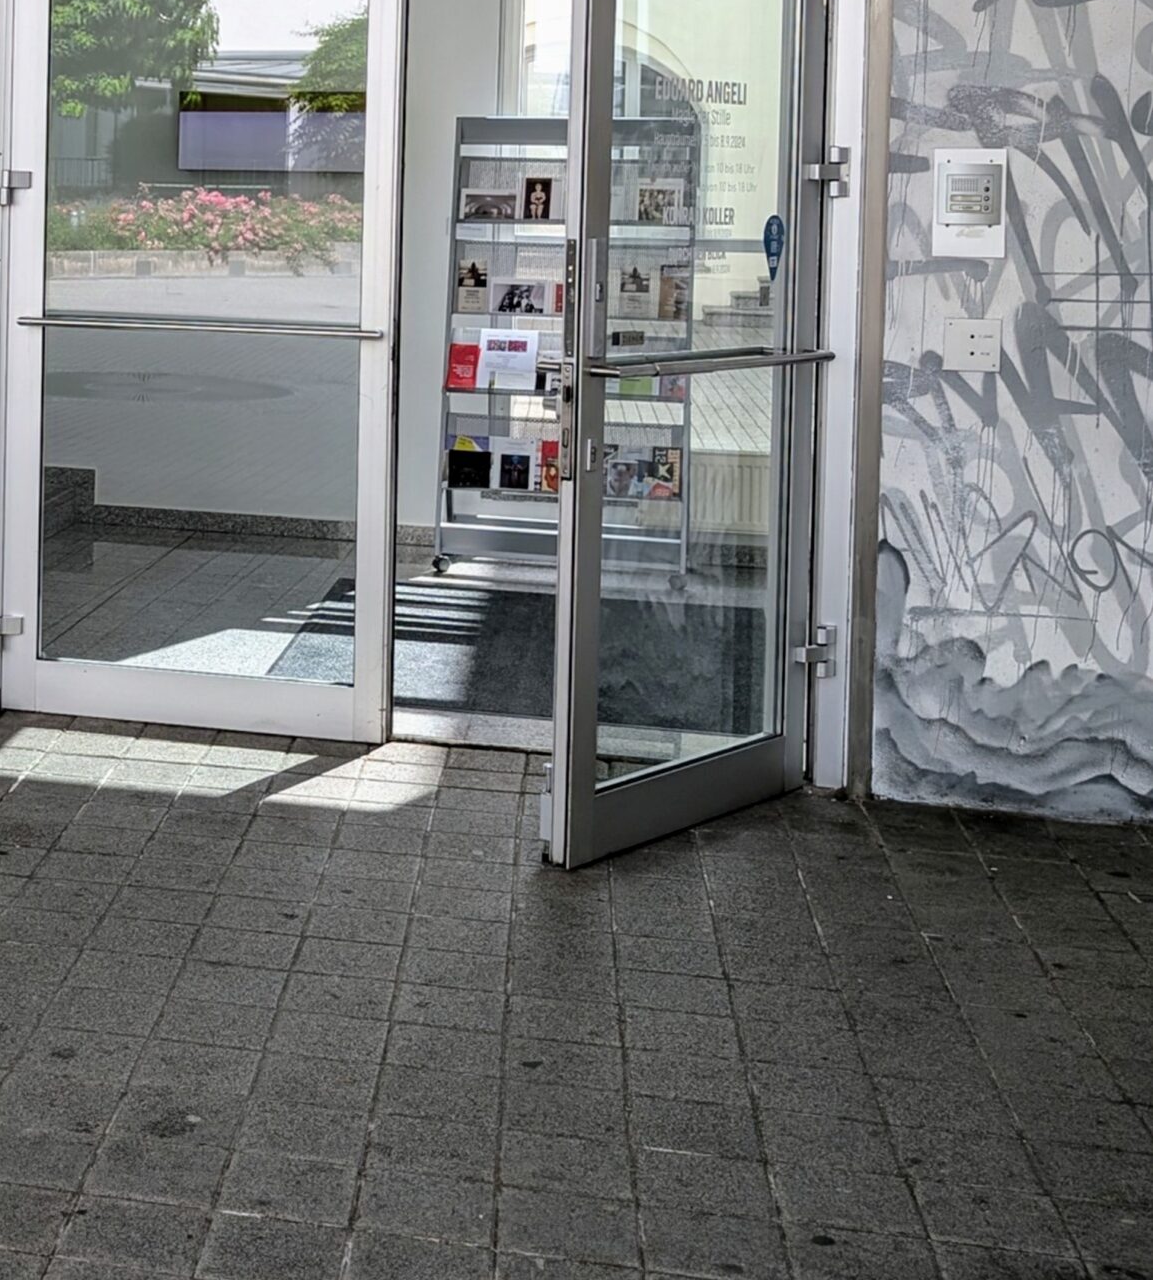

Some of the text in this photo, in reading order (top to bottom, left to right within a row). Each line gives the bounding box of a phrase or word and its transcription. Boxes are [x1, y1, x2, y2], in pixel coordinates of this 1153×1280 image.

[654, 76, 748, 105] EDUARD ANGELI
[711, 108, 731, 126] Stille
[744, 162, 756, 175] Uhr
[702, 207, 735, 226] KOLLER
